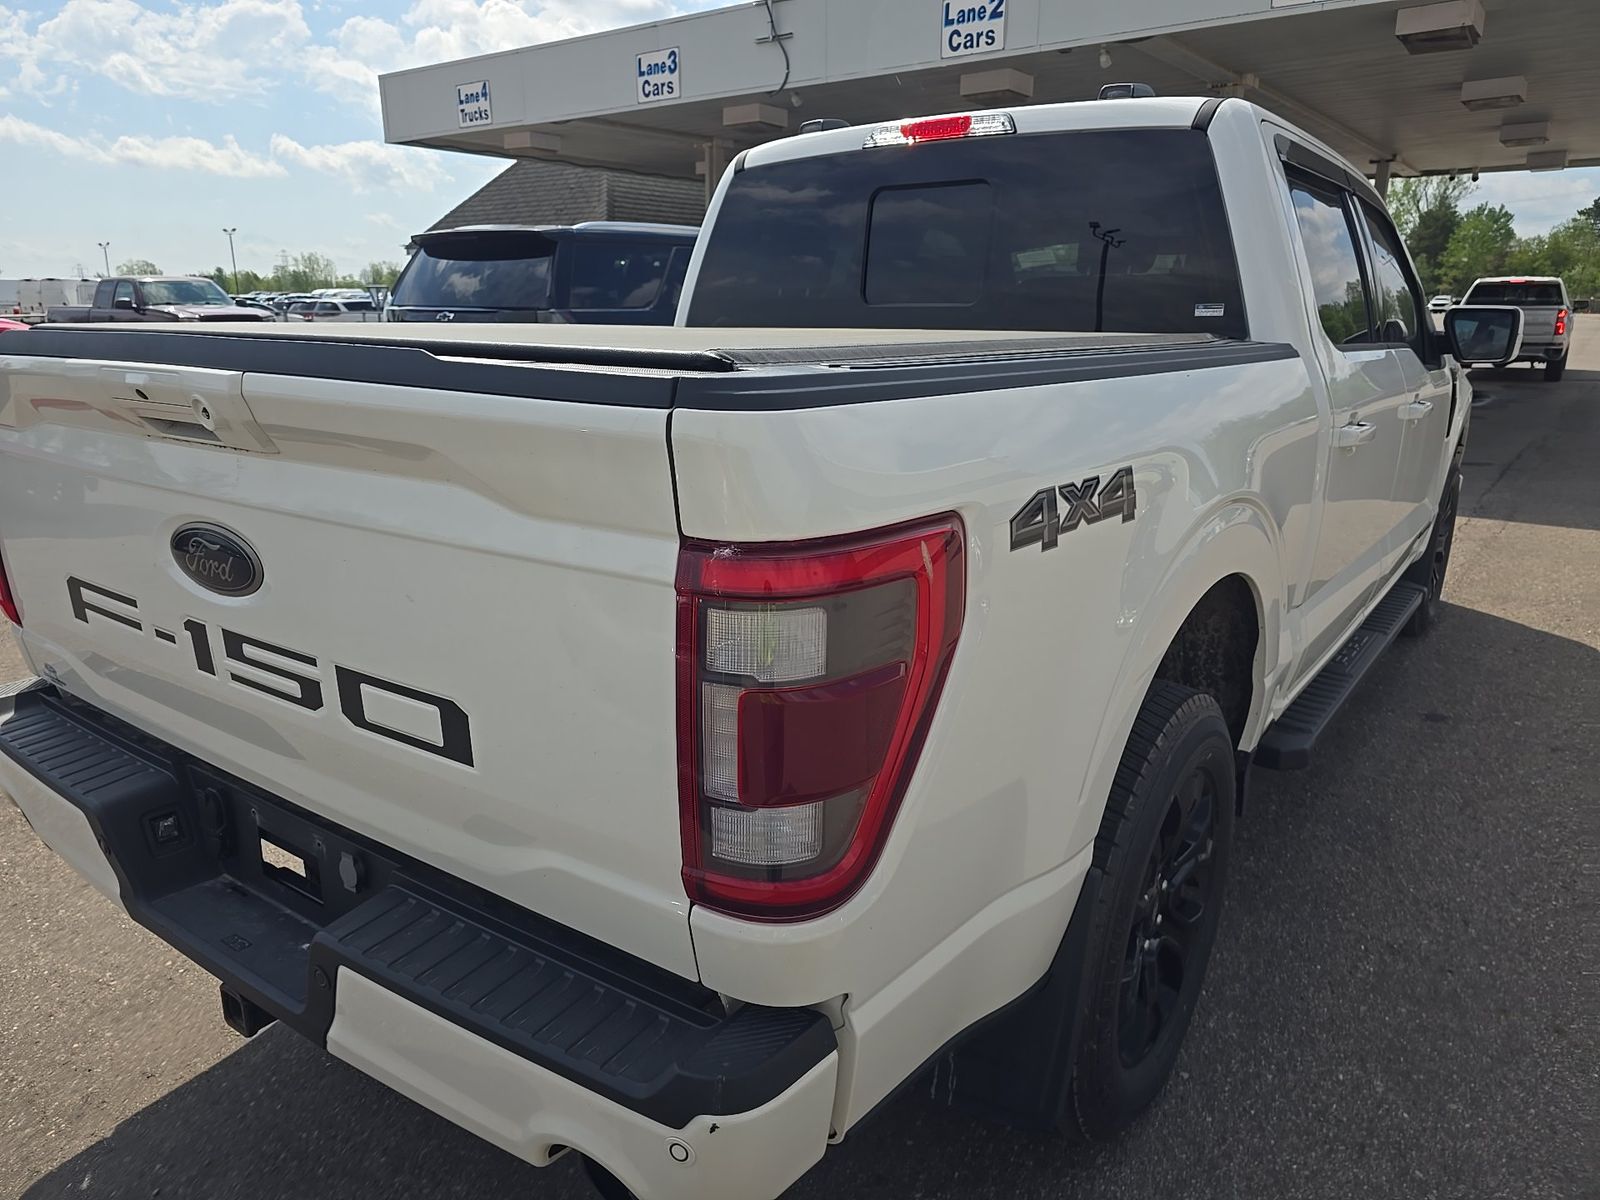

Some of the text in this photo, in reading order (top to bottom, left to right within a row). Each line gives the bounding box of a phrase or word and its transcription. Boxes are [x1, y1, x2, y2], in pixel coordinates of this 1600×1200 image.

[948, 29, 995, 52] Cars
[642, 80, 674, 98] Cars
[460, 106, 489, 123] Trucks
[185, 536, 234, 582] Ford
[66, 576, 475, 768] F-150
